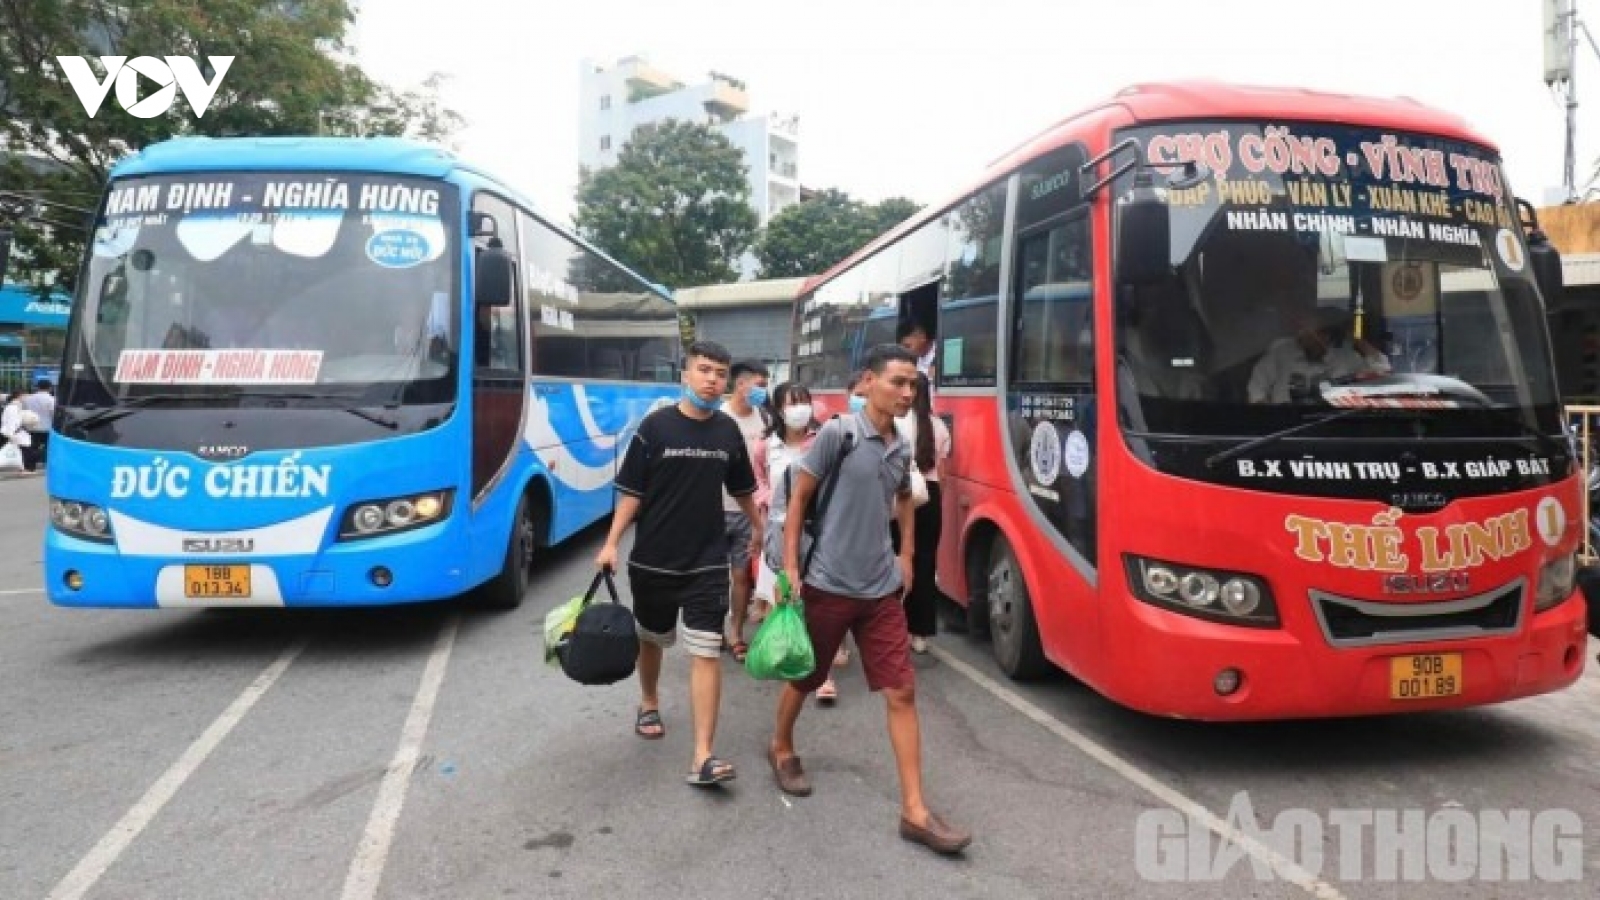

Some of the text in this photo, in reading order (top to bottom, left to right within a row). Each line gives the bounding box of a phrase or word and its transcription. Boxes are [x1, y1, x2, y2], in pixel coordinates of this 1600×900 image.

[1148, 130, 1233, 179] CHỢ
[1361, 134, 1449, 187] VĨNH
[104, 185, 160, 215] NAM
[166, 182, 233, 213] ĐỊNH
[262, 178, 349, 209] NGHĨA
[358, 182, 439, 215] HƯNG
[1331, 178, 1352, 207] LÝ
[1367, 183, 1416, 212] XUÂN
[1227, 208, 1288, 230] NHÂN
[1293, 208, 1356, 233] CHÍNH
[1428, 223, 1482, 247] NGHĨA
[118, 352, 162, 380] NAM
[161, 353, 205, 383] ĐỊNH
[110, 450, 331, 498] ĐỨC CHIẾN
[1237, 459, 1283, 477] B.X
[1289, 455, 1352, 479] VĨNH
[1353, 462, 1401, 484] TRỤ
[1421, 462, 1461, 479] B.X
[1464, 455, 1512, 477] GIÁP
[182, 538, 254, 552] ISUZU
[1285, 506, 1532, 573] THẾ LINH
[204, 567, 231, 580] 18B
[1412, 656, 1443, 676] 90B
[1400, 676, 1455, 697] 001.89
